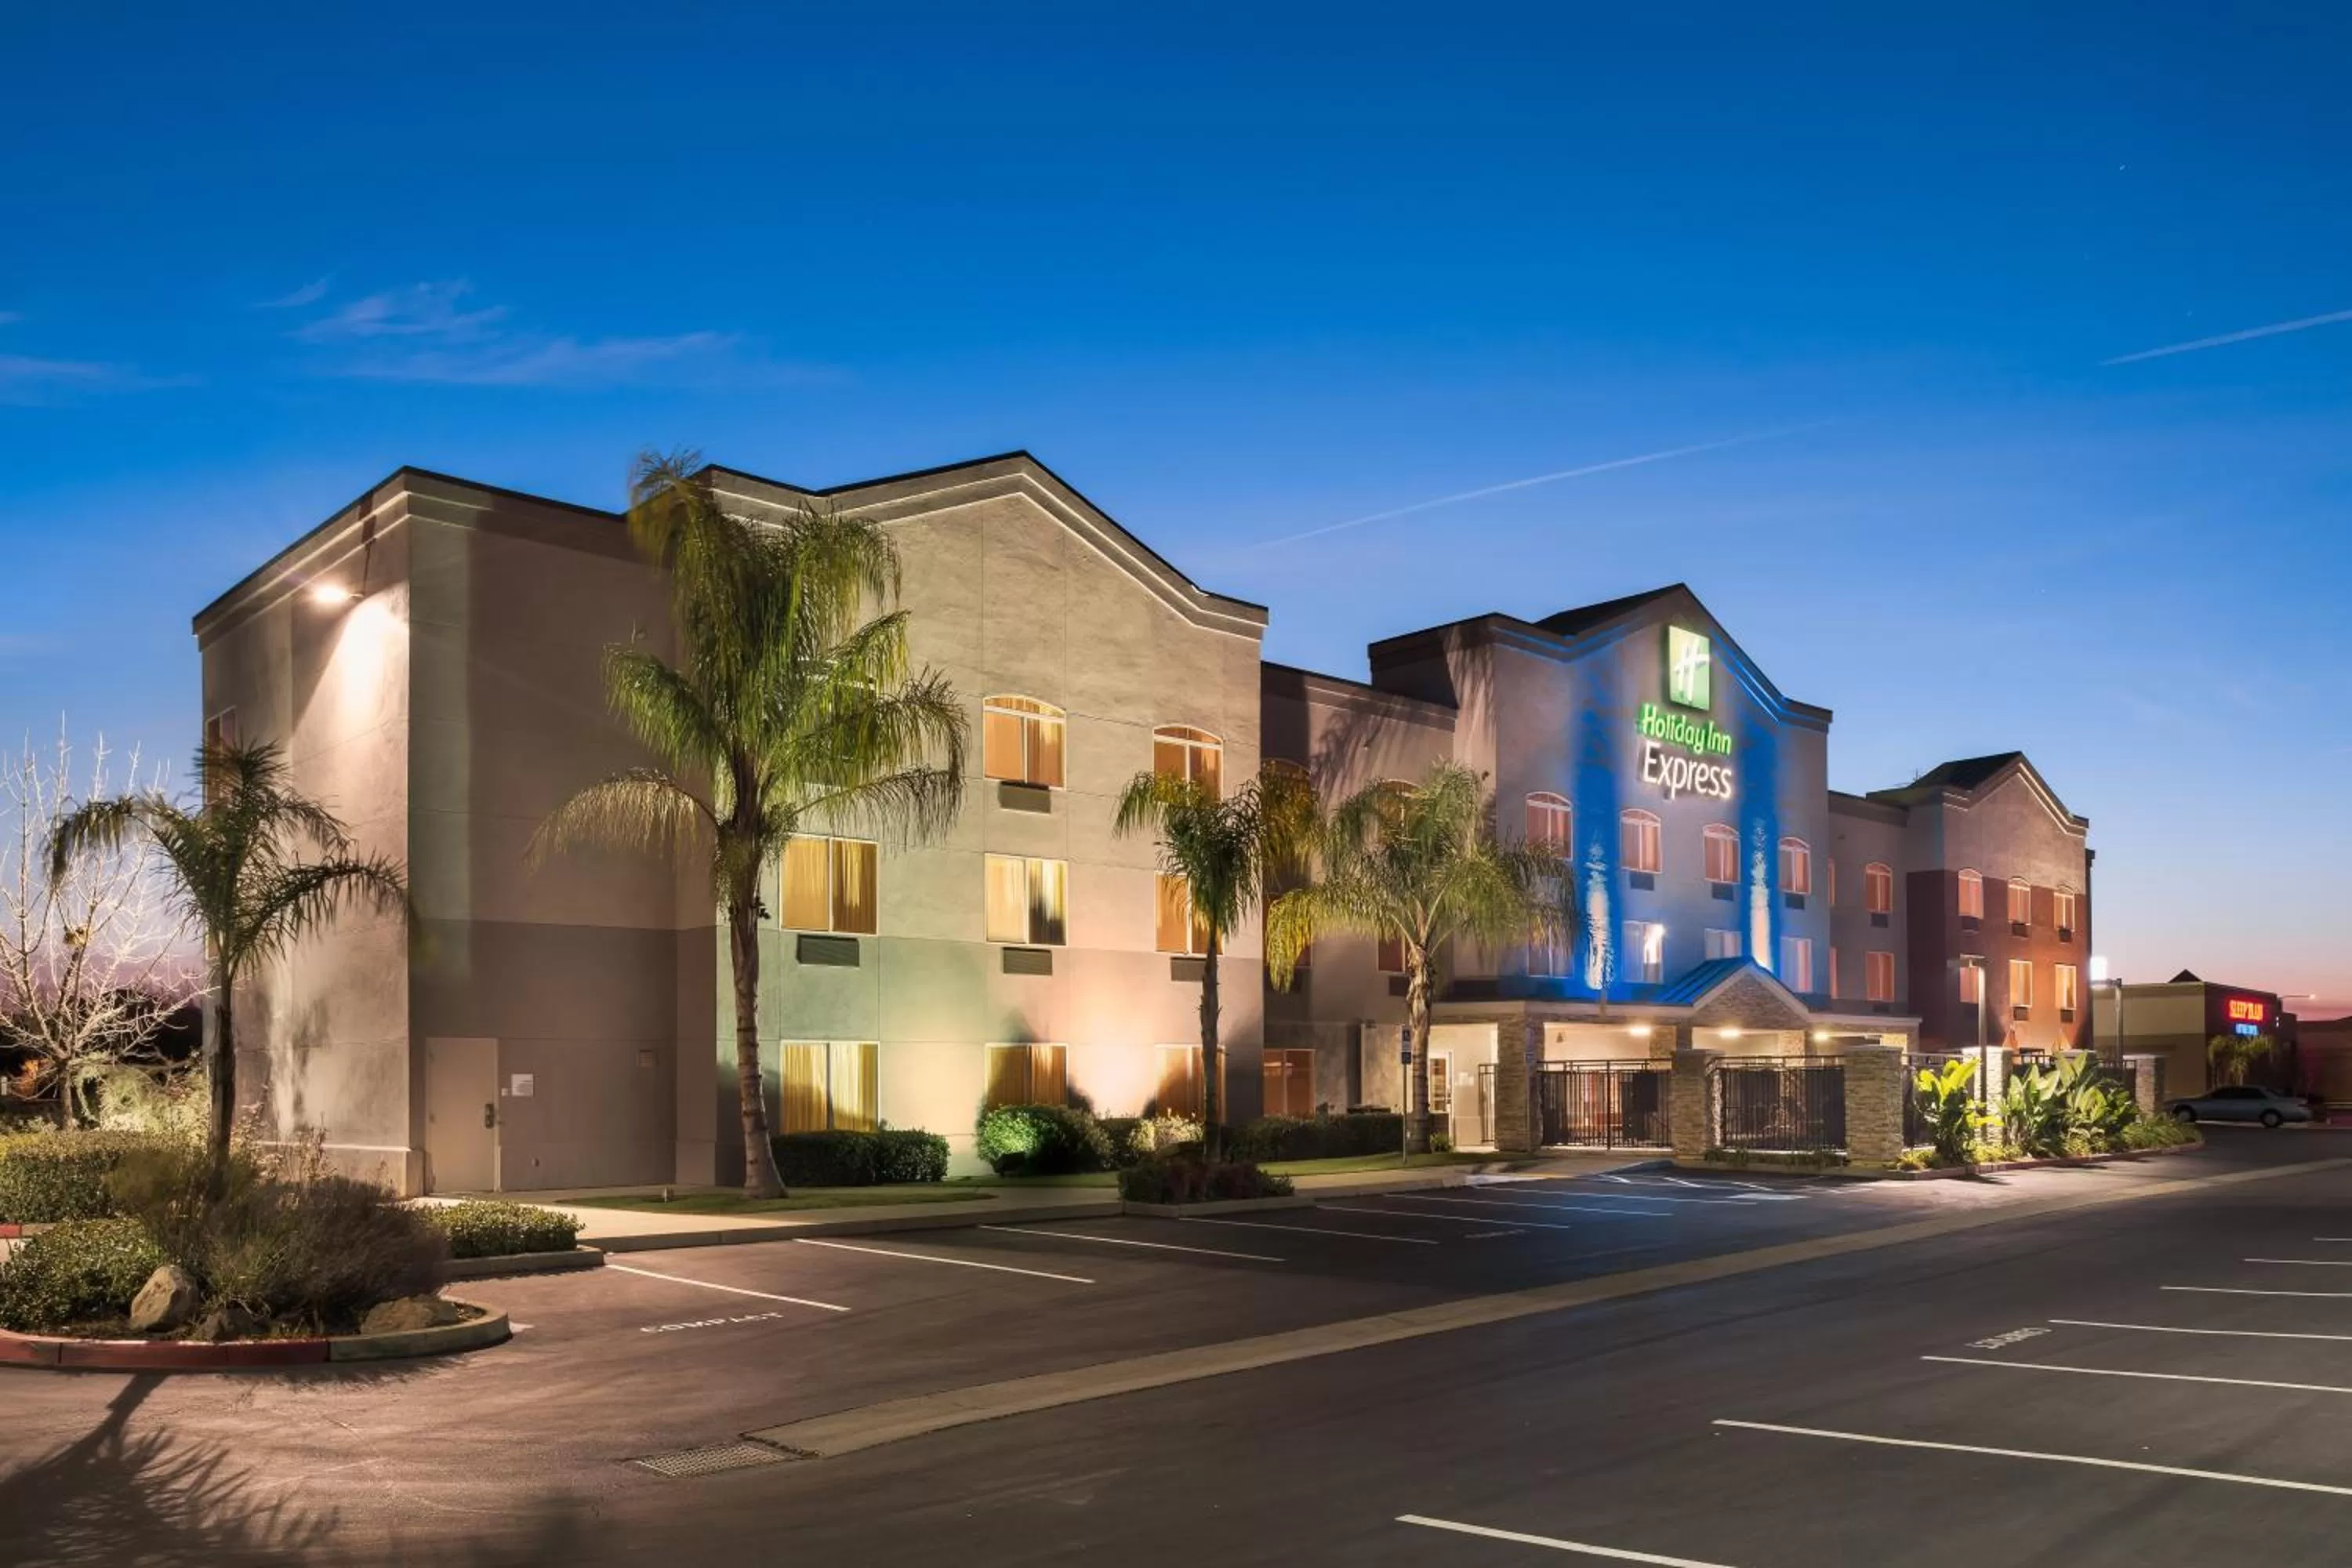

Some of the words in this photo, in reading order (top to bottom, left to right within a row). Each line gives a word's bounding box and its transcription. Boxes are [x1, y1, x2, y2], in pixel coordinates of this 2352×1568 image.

[1642, 703, 1704, 753] Holiday
[1708, 720, 1731, 754] Inn
[1643, 740, 1732, 799] Express
